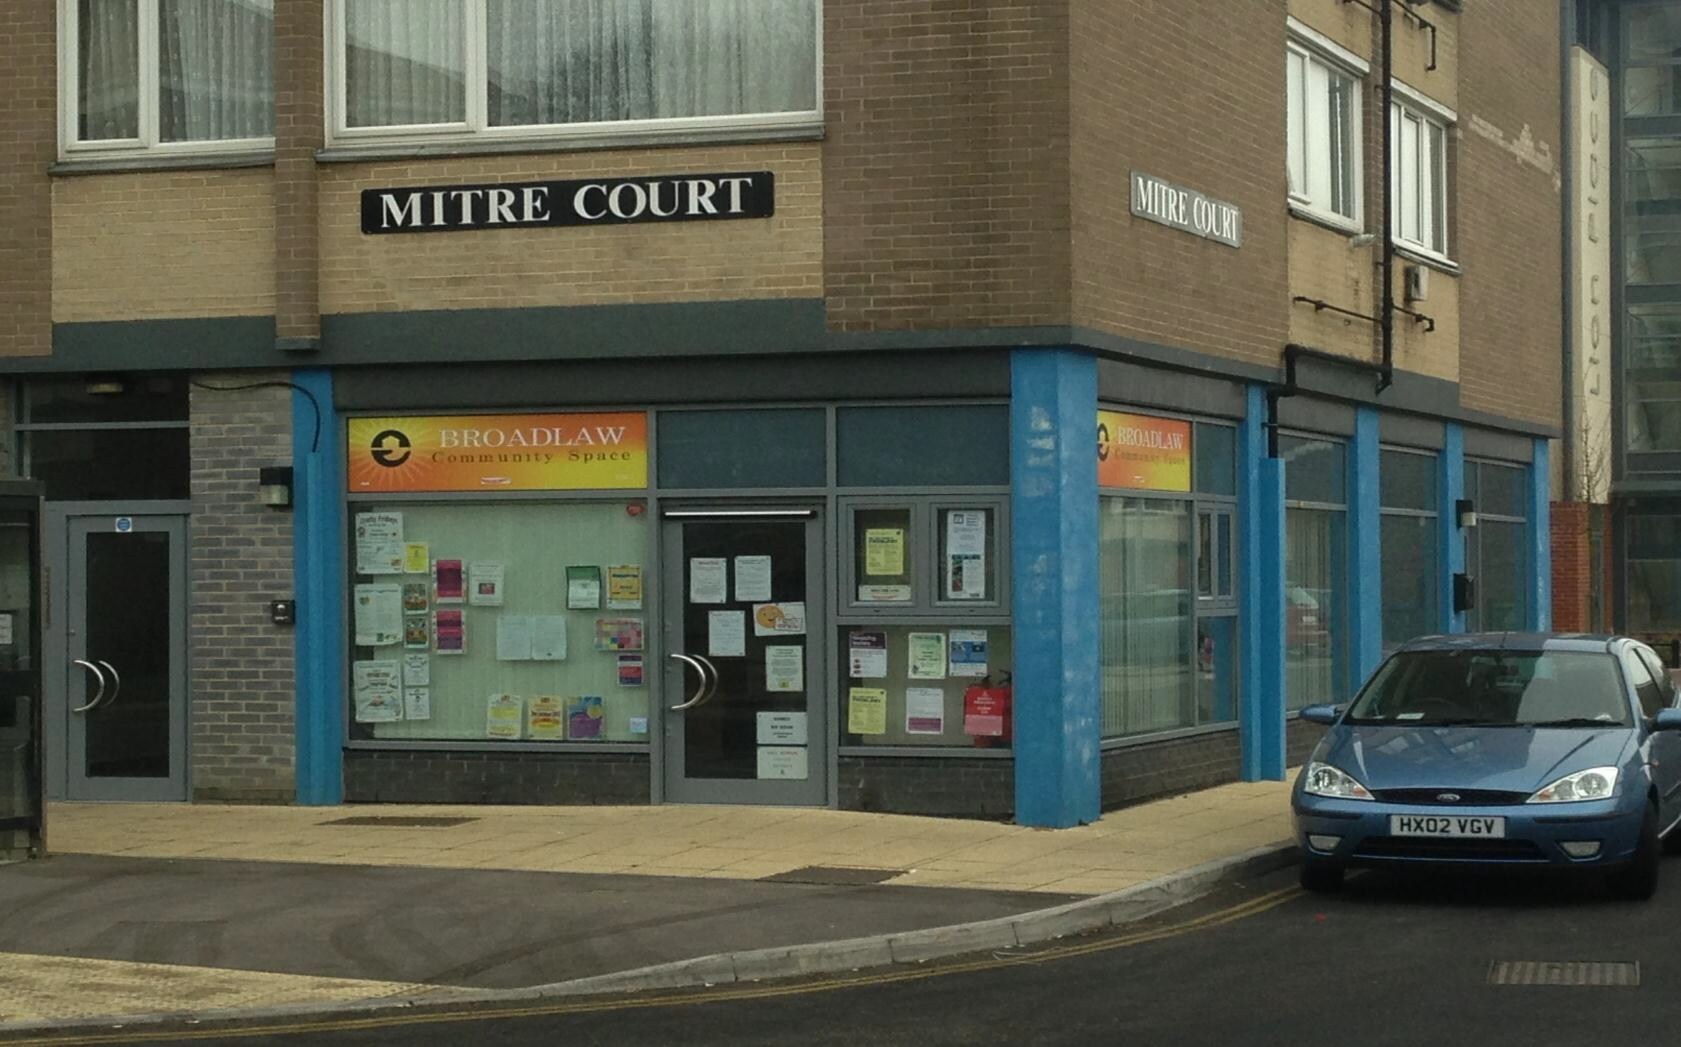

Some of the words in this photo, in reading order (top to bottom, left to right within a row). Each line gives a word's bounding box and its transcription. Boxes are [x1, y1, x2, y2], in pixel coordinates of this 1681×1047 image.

[379, 186, 551, 228] MITRE
[573, 177, 752, 219] COURT
[1137, 176, 1188, 225] MITRE
[1193, 197, 1239, 241] COURT
[439, 426, 626, 448] BROADLAW
[1117, 426, 1184, 450] BROADLAW
[432, 450, 554, 465] Community
[568, 449, 632, 463] Space
[1400, 817, 1451, 833] HX02
[1458, 818, 1495, 834] VGV
